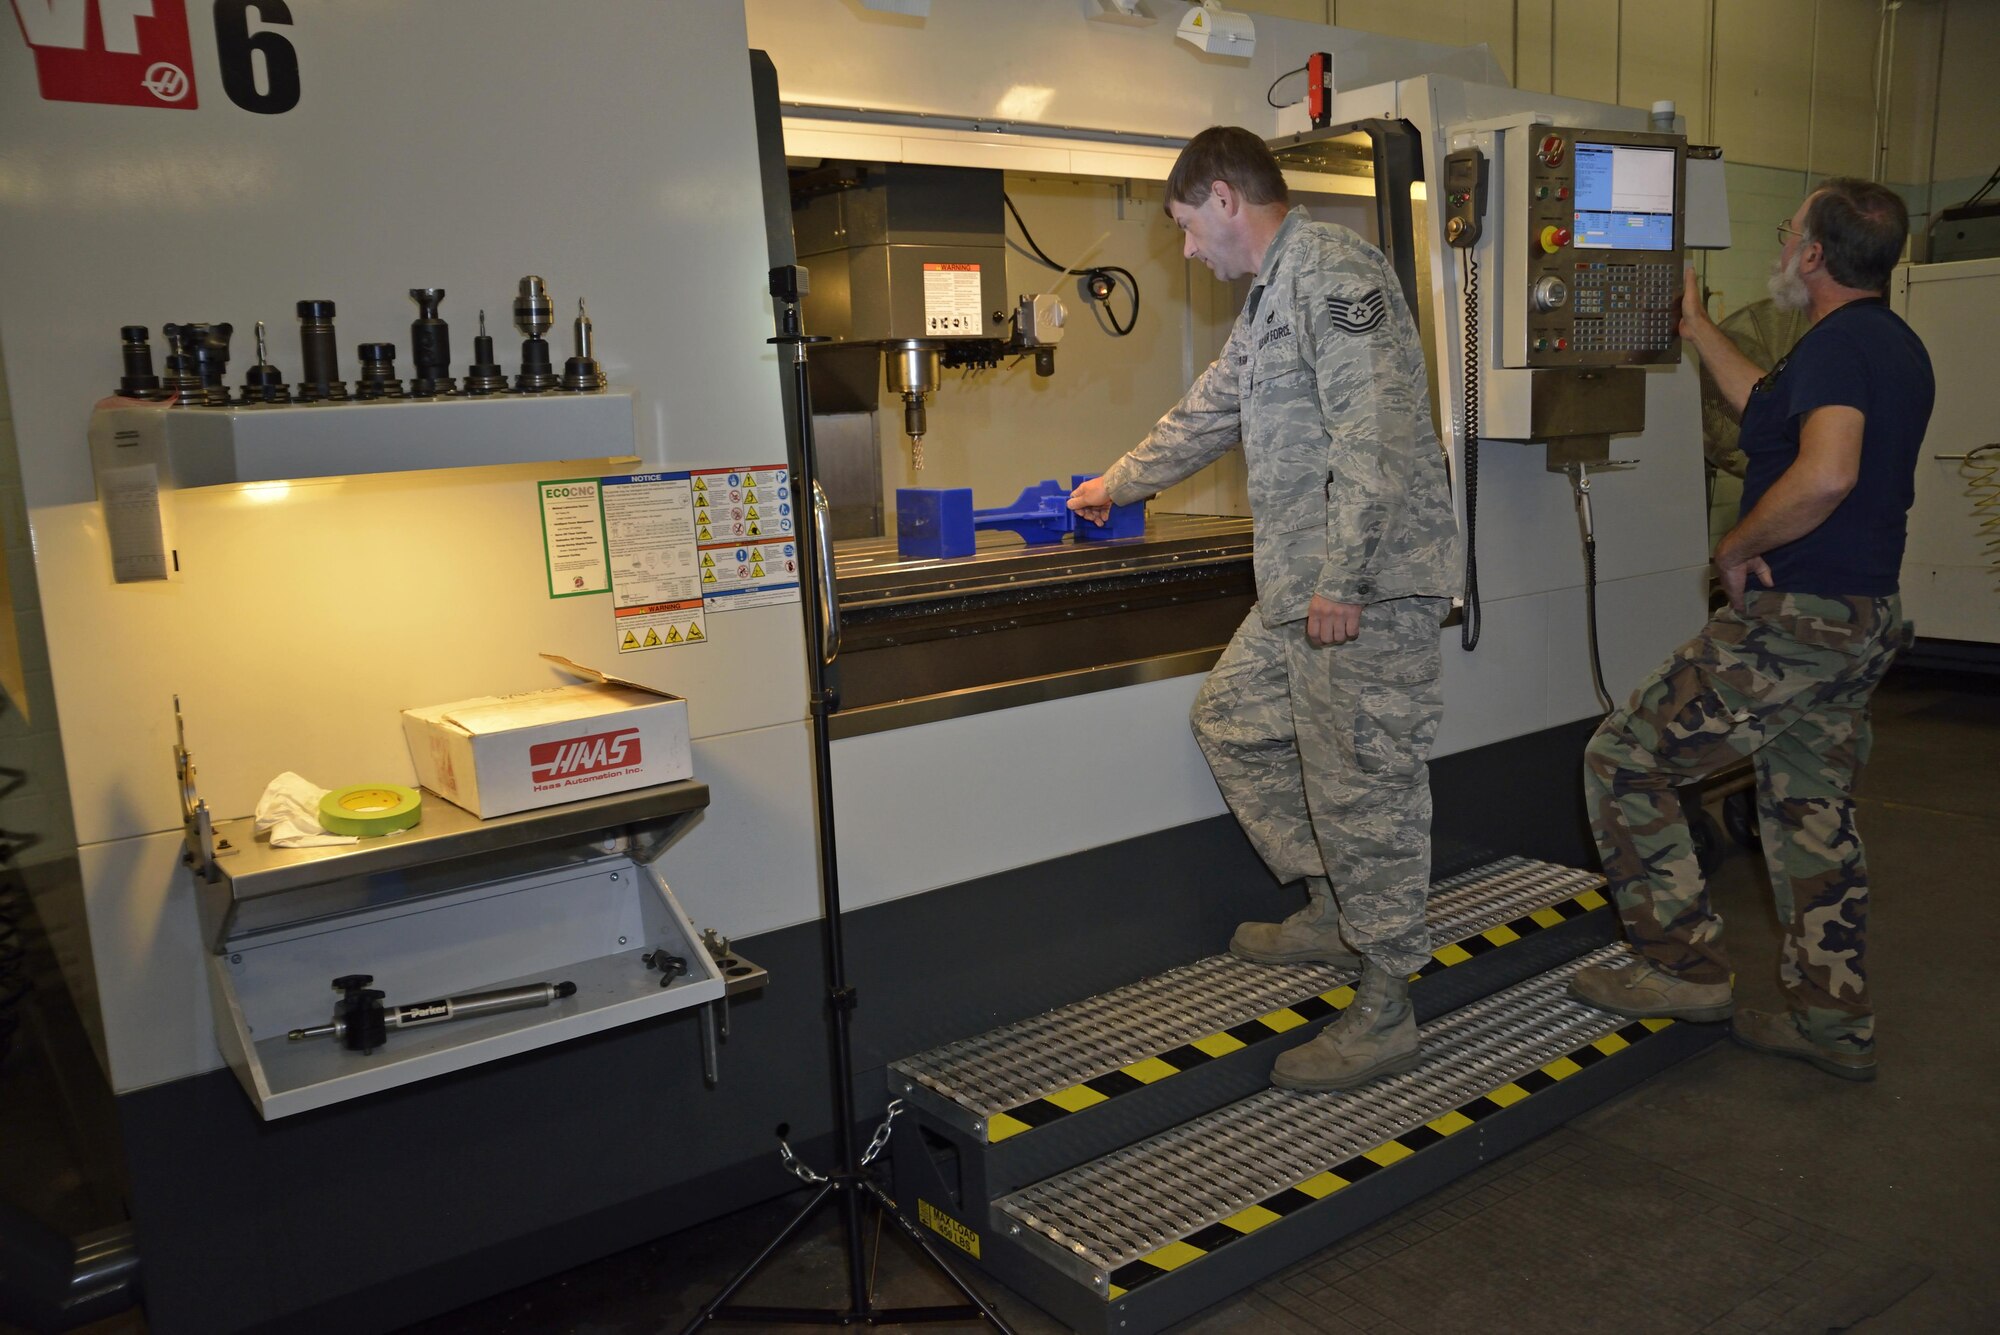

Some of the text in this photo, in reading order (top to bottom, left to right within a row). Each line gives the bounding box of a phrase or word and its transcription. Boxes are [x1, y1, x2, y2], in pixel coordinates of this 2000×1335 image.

[213, 0, 300, 115] 6
[1270, 324, 1291, 342] FORCE
[631, 474, 662, 483] NOTICE
[545, 486, 595, 499] ECOCNC
[648, 603, 681, 612] WARNING
[531, 731, 640, 776] HAAS
[533, 766, 643, 792] Haas Automation Inc.
[410, 1005, 446, 1018] Parker
[933, 1208, 951, 1227] MAX
[953, 1219, 976, 1242] LOAD
[955, 1233, 971, 1251] LBS
